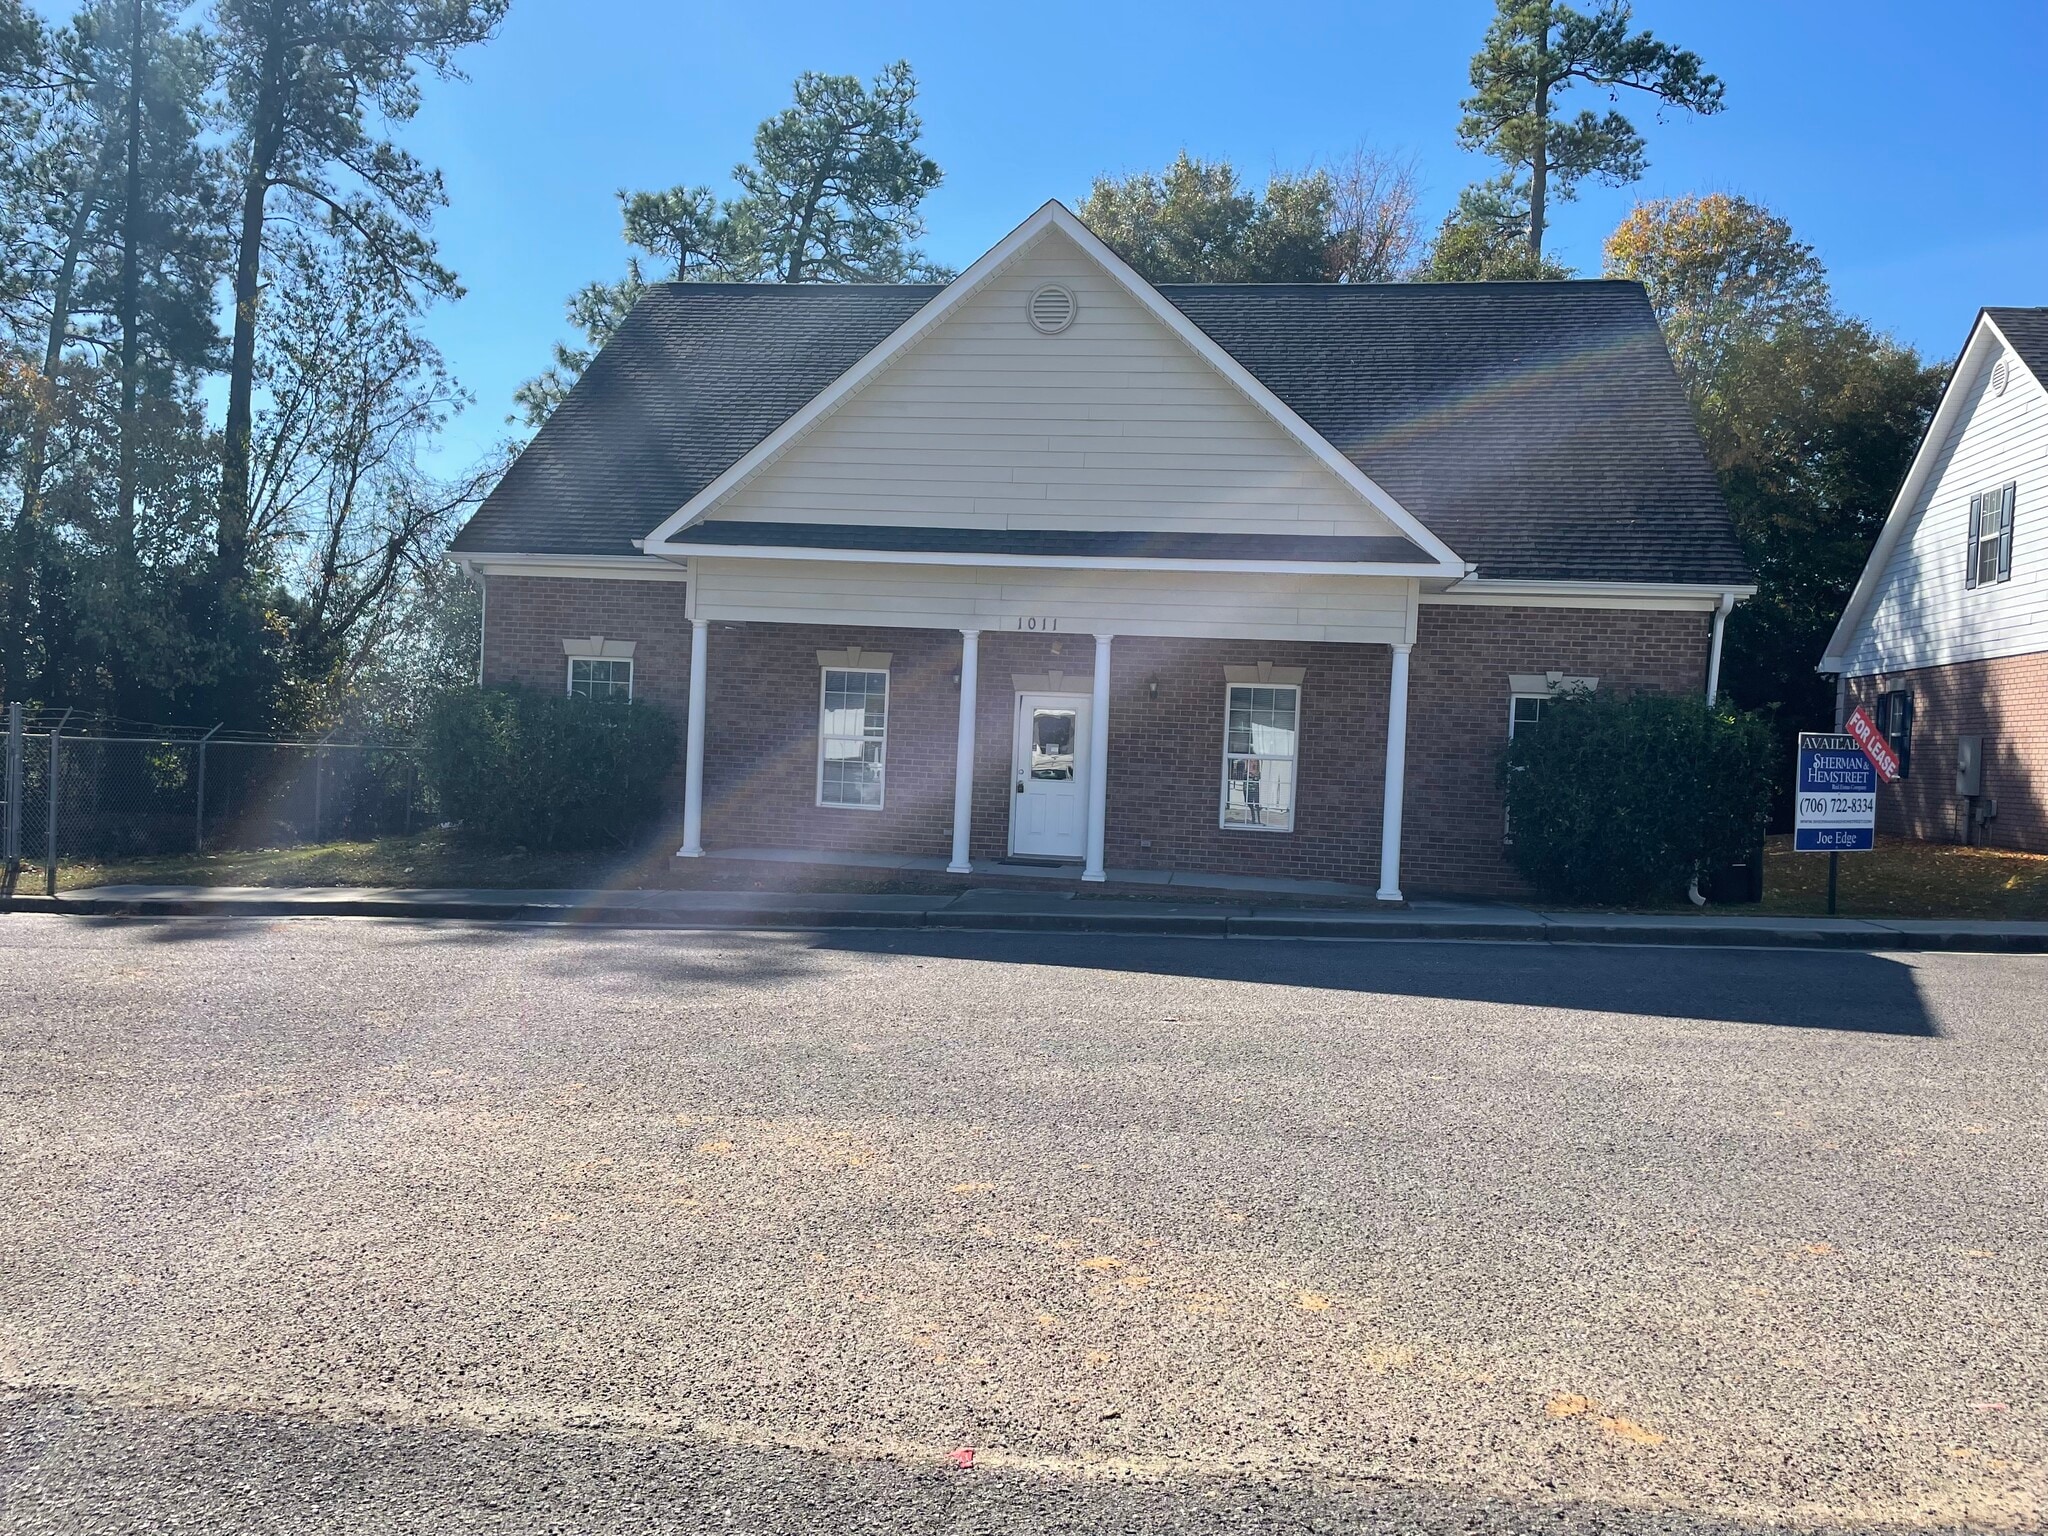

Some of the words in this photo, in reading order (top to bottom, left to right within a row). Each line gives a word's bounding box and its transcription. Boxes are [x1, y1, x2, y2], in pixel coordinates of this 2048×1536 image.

[1018, 617, 1057, 631] 1011
[1802, 737, 1861, 750] AVAILAB
[1850, 712, 1870, 743] FOR
[1867, 737, 1896, 778] LEASE
[1813, 753, 1863, 769] SHERMAN
[1863, 761, 1869, 770] &
[1808, 767, 1869, 783] HEMSTREET
[1800, 797, 1827, 816] (706)
[1831, 799, 1873, 813] 722-8334
[1817, 831, 1832, 844] Joe
[1835, 831, 1857, 847] Edge
